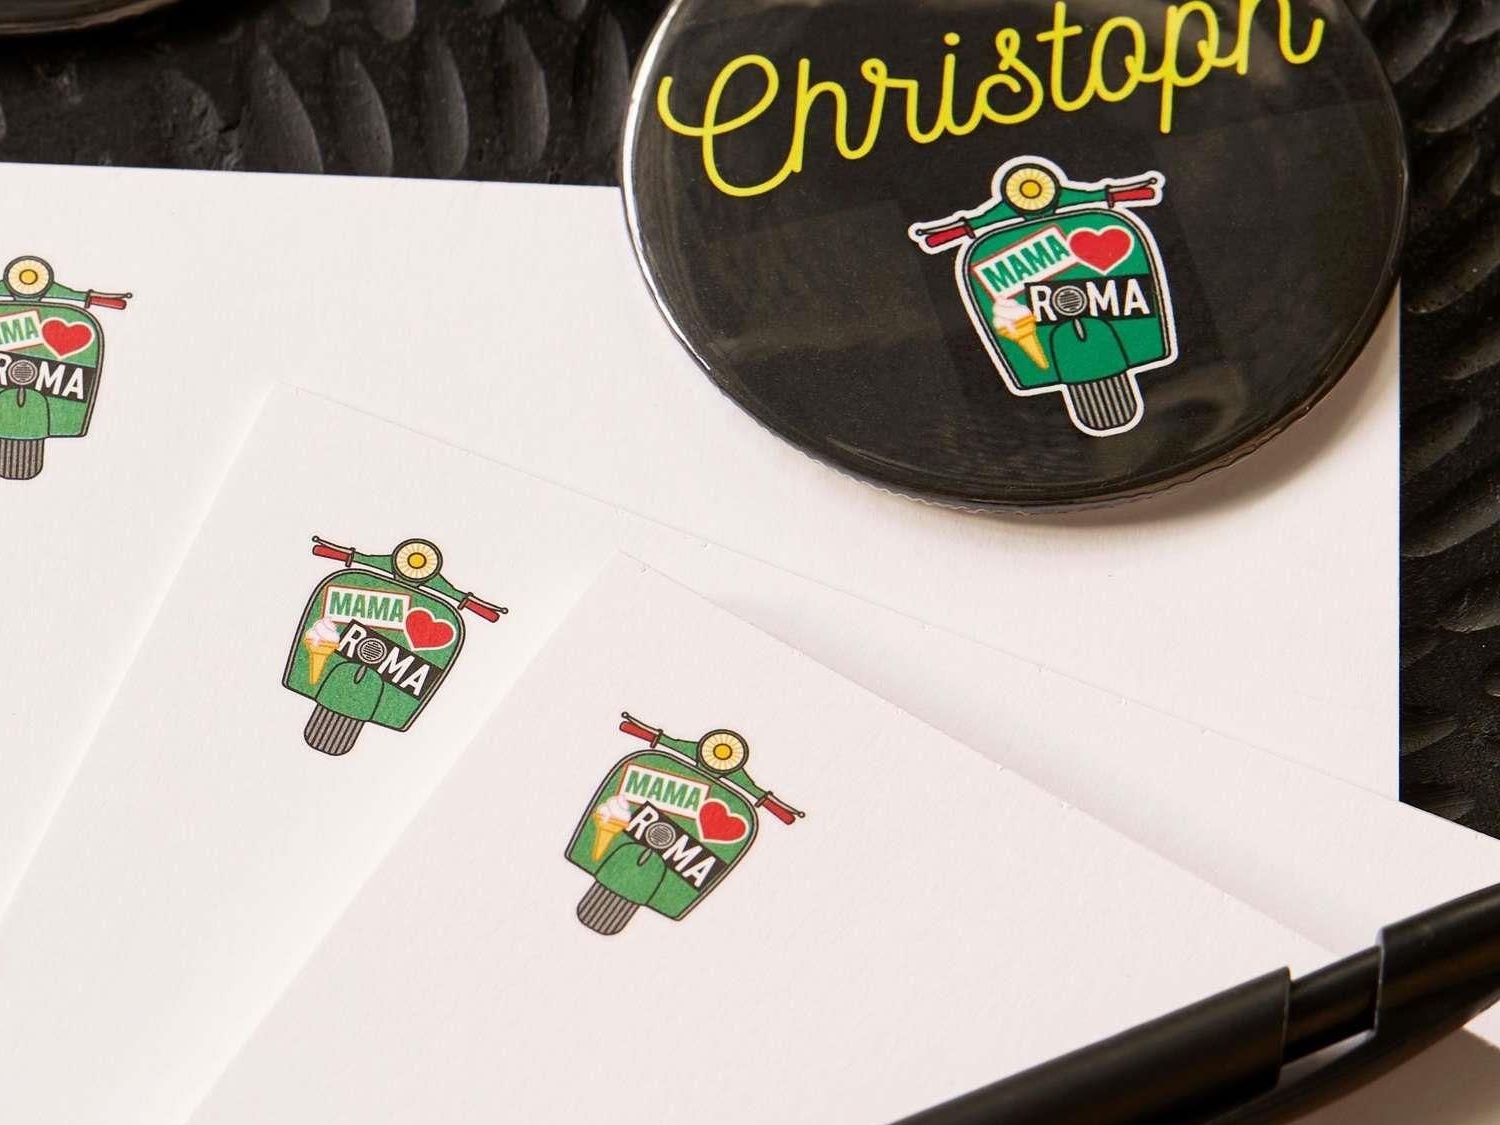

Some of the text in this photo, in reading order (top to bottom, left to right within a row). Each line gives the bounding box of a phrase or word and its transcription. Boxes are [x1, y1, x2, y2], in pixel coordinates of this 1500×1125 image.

[656, 0, 1325, 198] Christoph
[980, 233, 1072, 294] MAMA
[1029, 278, 1151, 324] ROMA
[328, 591, 405, 624] MAMA
[338, 623, 432, 697] ROMA
[623, 769, 705, 812] MAMA
[627, 805, 717, 888] ROMA
